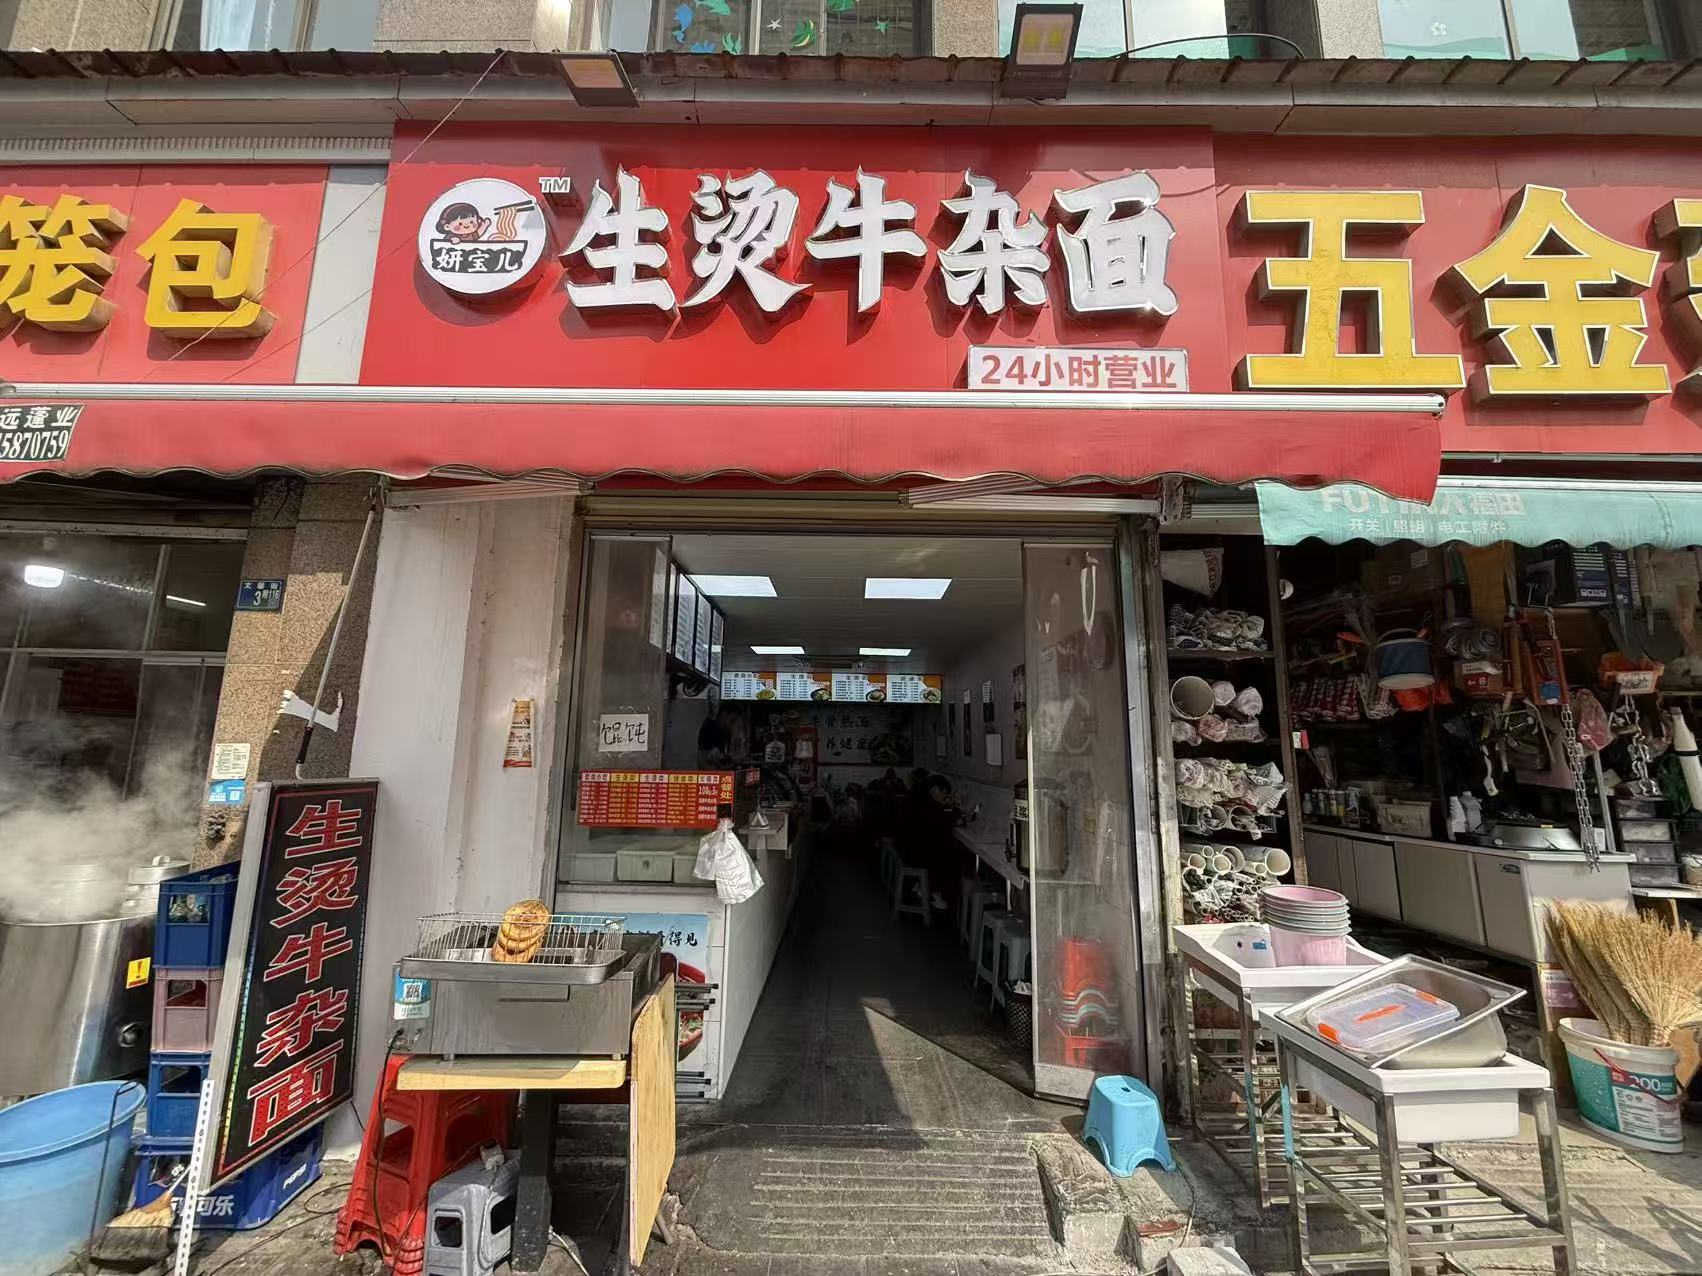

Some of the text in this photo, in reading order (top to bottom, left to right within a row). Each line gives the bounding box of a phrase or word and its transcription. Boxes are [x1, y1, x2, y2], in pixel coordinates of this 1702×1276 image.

[539, 177, 571, 194] TM
[0, 194, 270, 332] 笼包
[435, 248, 523, 273] 妍宝儿
[557, 163, 1180, 316] 生烫牛杂面
[1245, 184, 1702, 394] 五金
[981, 353, 1178, 391] 24小时营业
[601, 721, 646, 745] 馄饨
[248, 799, 363, 1147] 生烫牛杂面
